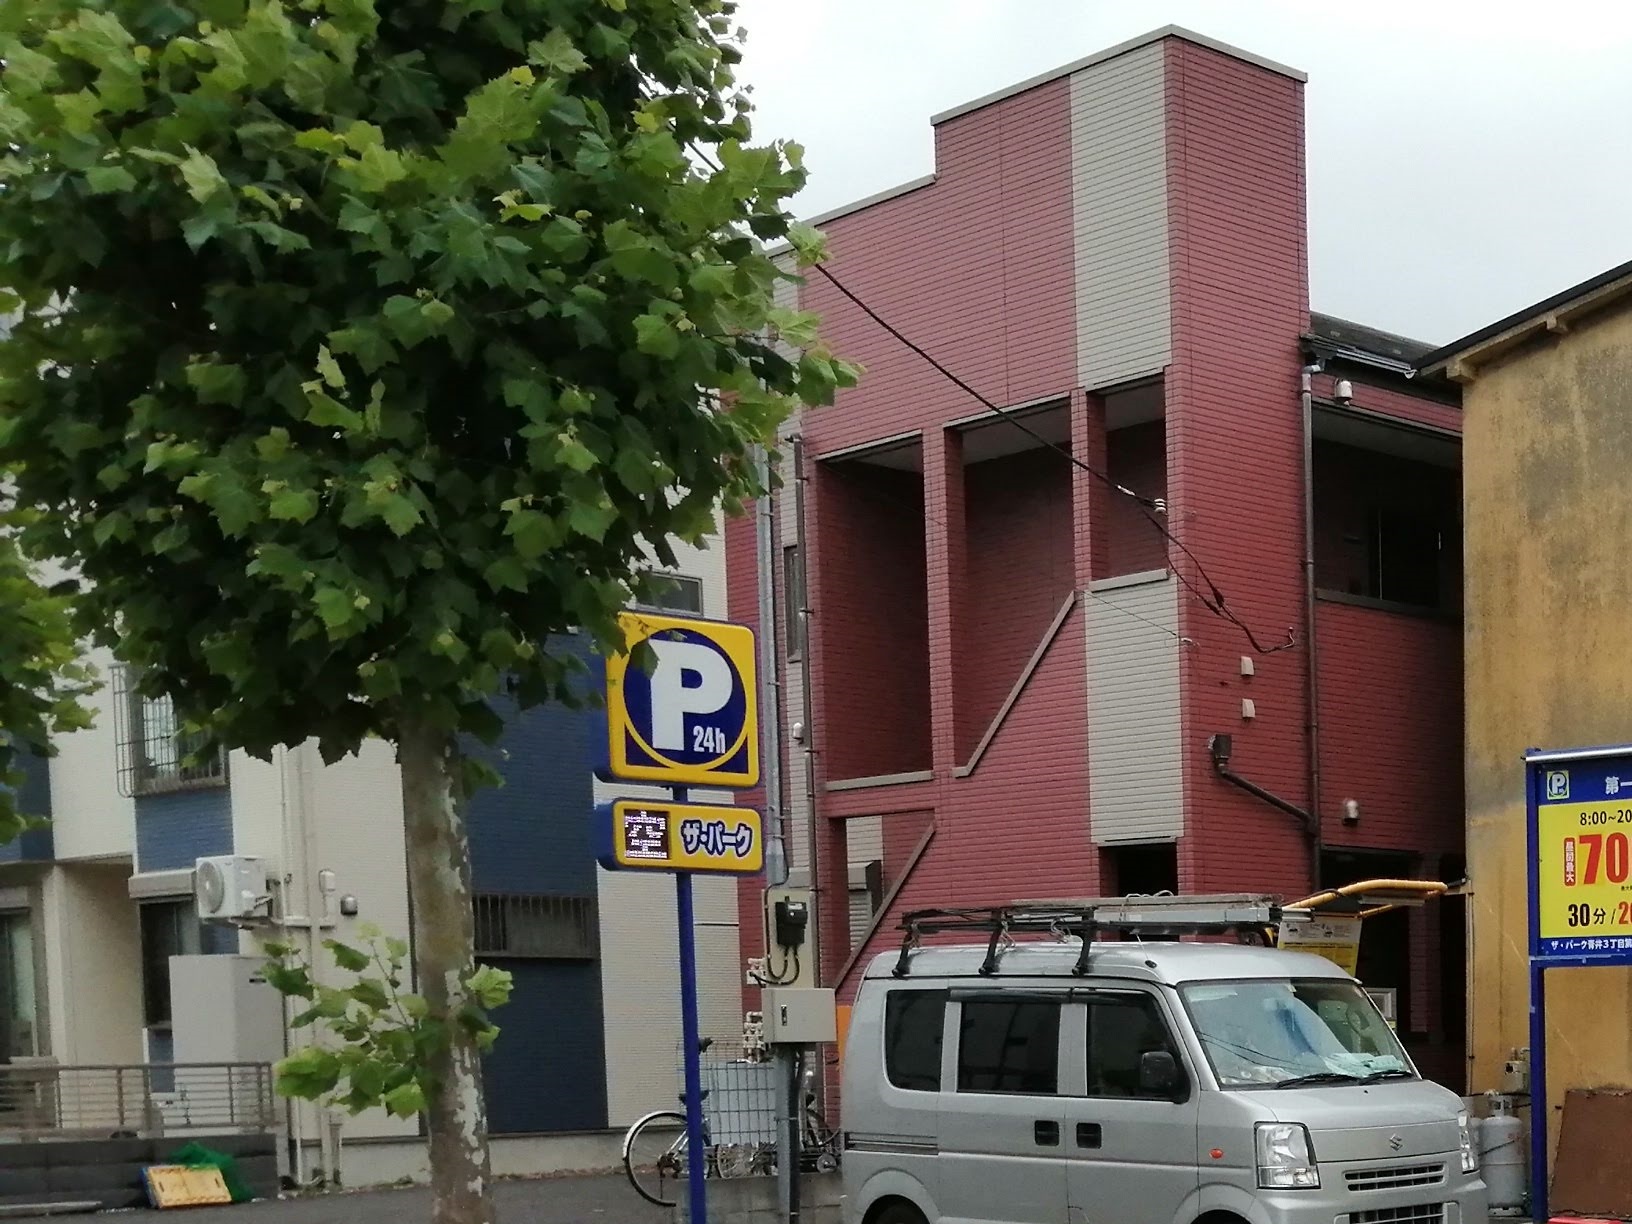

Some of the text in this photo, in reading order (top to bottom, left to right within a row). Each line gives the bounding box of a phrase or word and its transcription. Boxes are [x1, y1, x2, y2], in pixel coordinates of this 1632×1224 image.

[650, 639, 733, 751] P
[693, 725, 726, 754] 24h
[625, 810, 668, 858] 空
[682, 819, 753, 858] ザ・パーク
